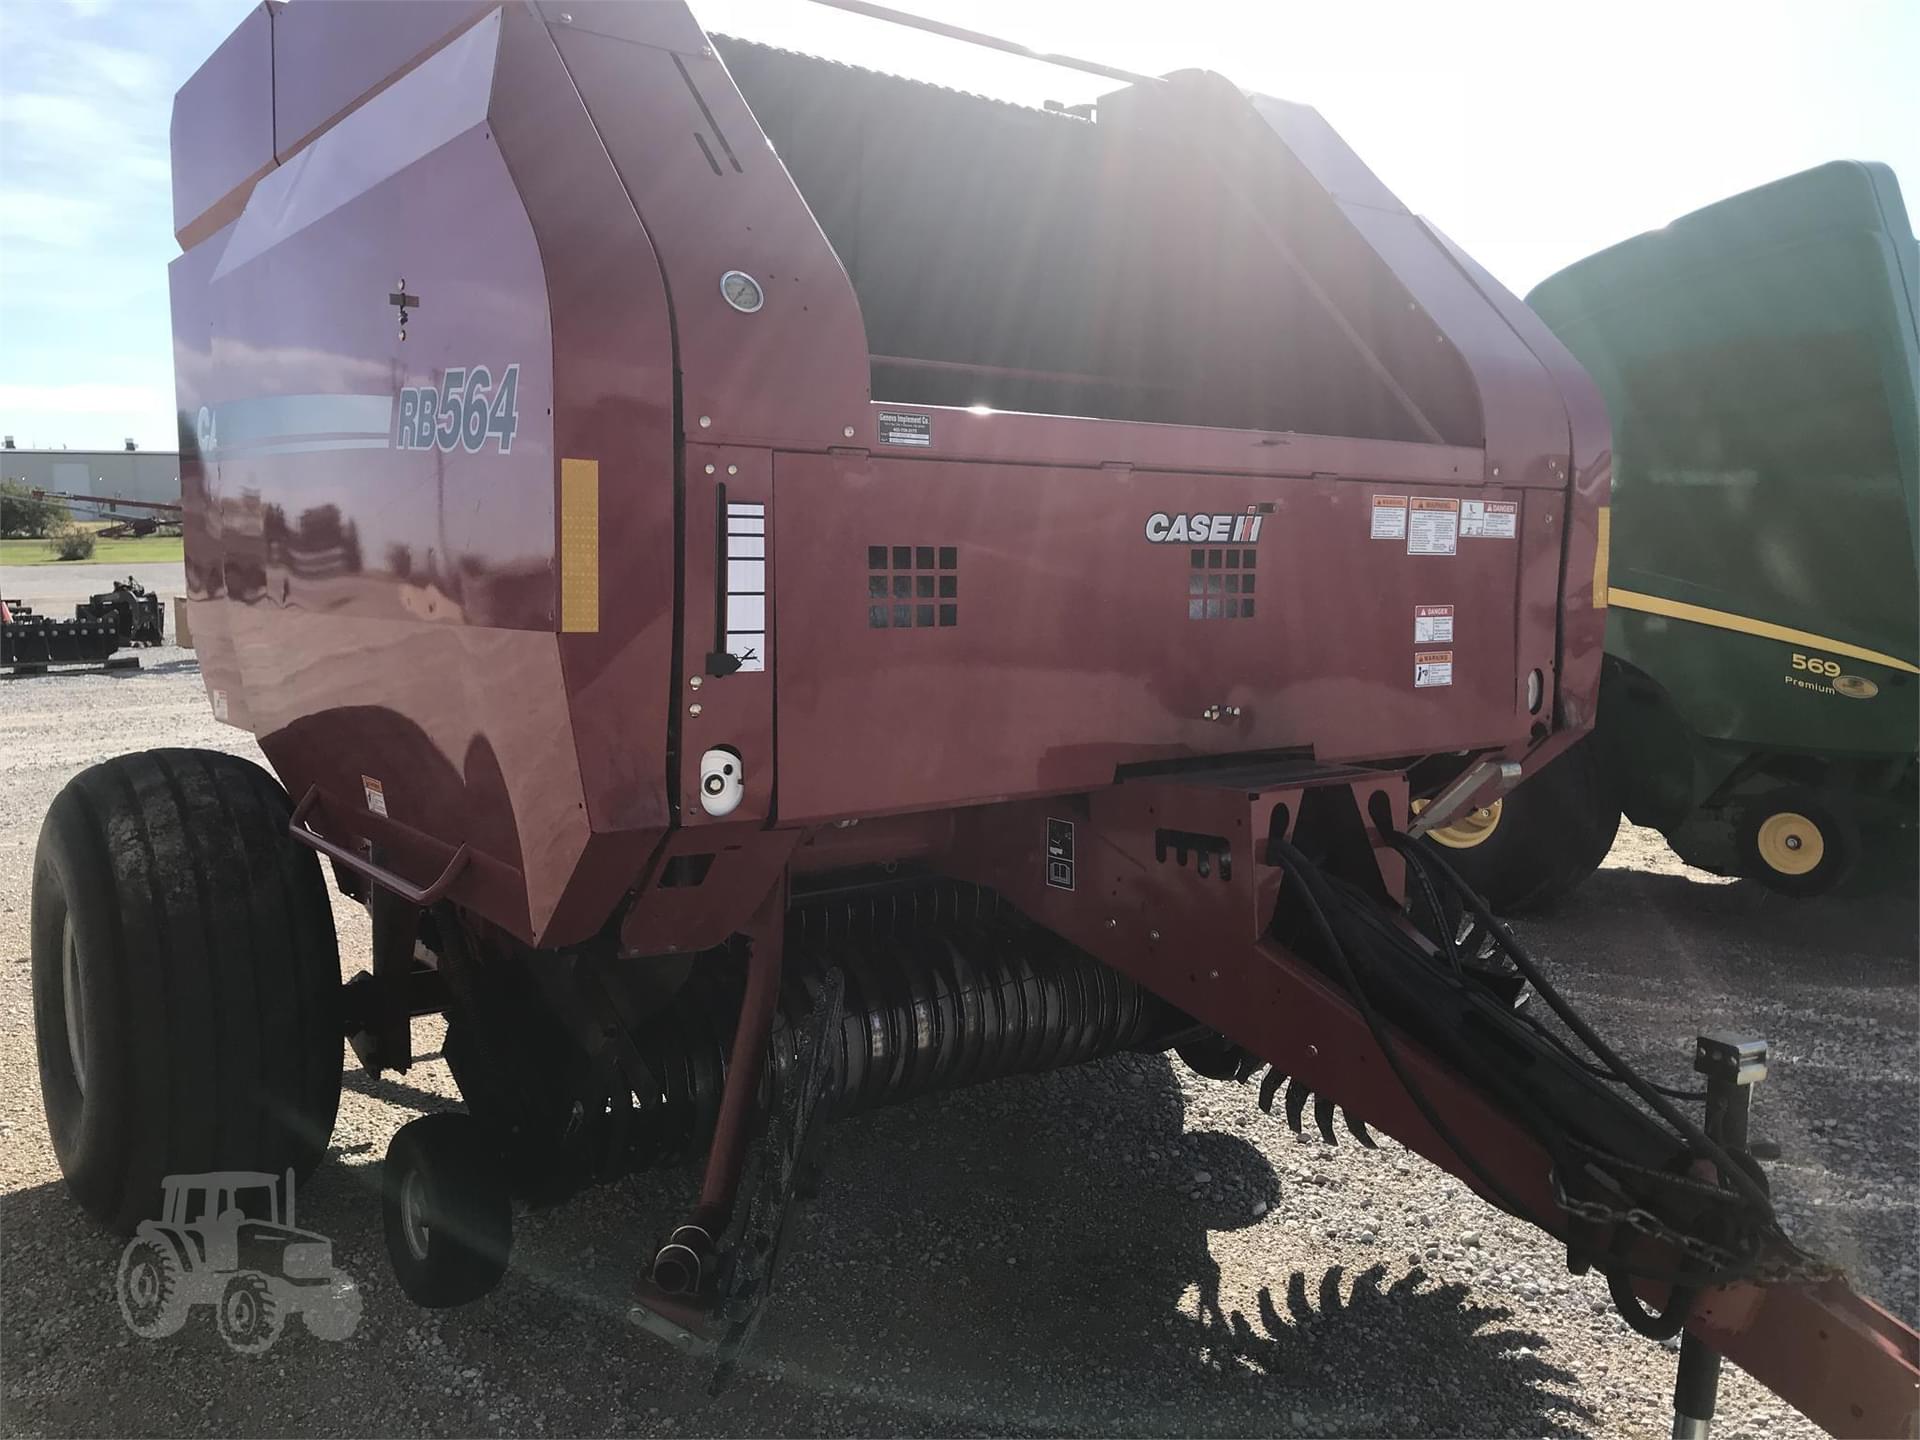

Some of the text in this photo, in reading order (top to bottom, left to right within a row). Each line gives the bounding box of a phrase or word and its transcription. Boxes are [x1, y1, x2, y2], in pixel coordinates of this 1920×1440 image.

[396, 363, 520, 454] RB564
[1492, 504, 1515, 513] DANGER
[1792, 653, 1841, 678] 569
[1785, 676, 1836, 695] Premium
